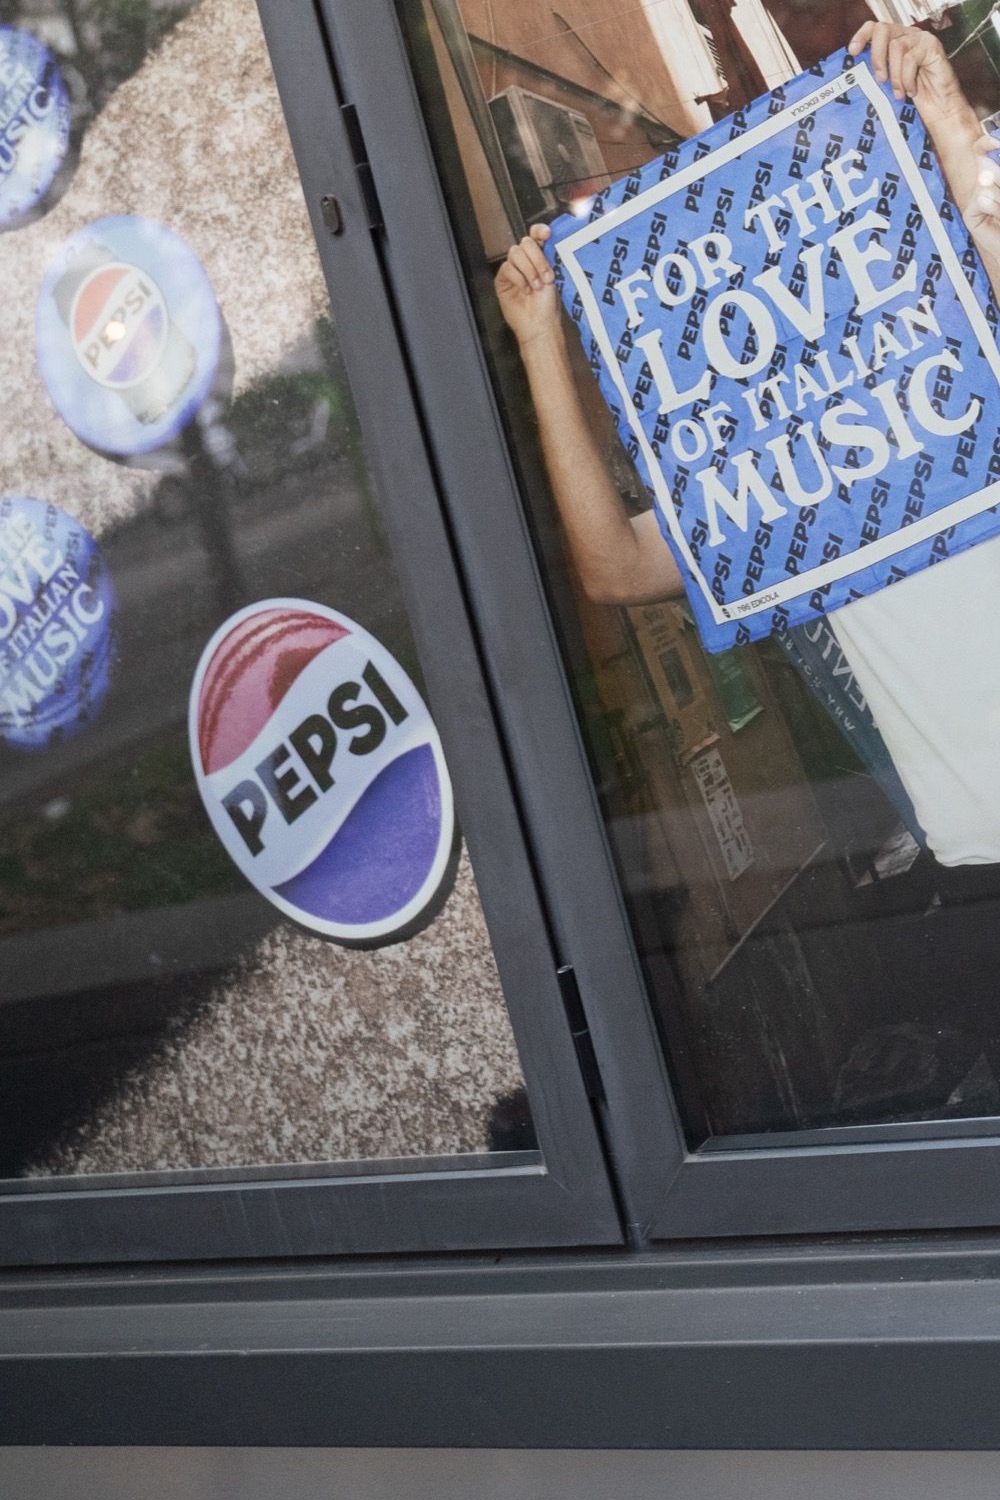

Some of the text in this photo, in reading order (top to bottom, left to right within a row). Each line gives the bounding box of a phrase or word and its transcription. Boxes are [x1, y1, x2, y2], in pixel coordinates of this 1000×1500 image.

[603, 238, 628, 305] PEPSI
[614, 231, 746, 329] FOR
[745, 149, 880, 255] THE
[633, 210, 918, 415] LOVE
[671, 401, 732, 463] OF
[742, 296, 945, 428] ITALIAN
[678, 288, 708, 360] PEPSI
[695, 349, 983, 547] MUSIC
[8, 563, 81, 660] ITALIAN
[743, 521, 772, 596] PEPSI
[2, 583, 105, 727] MUSIC
[220, 659, 409, 858] PEPSI
